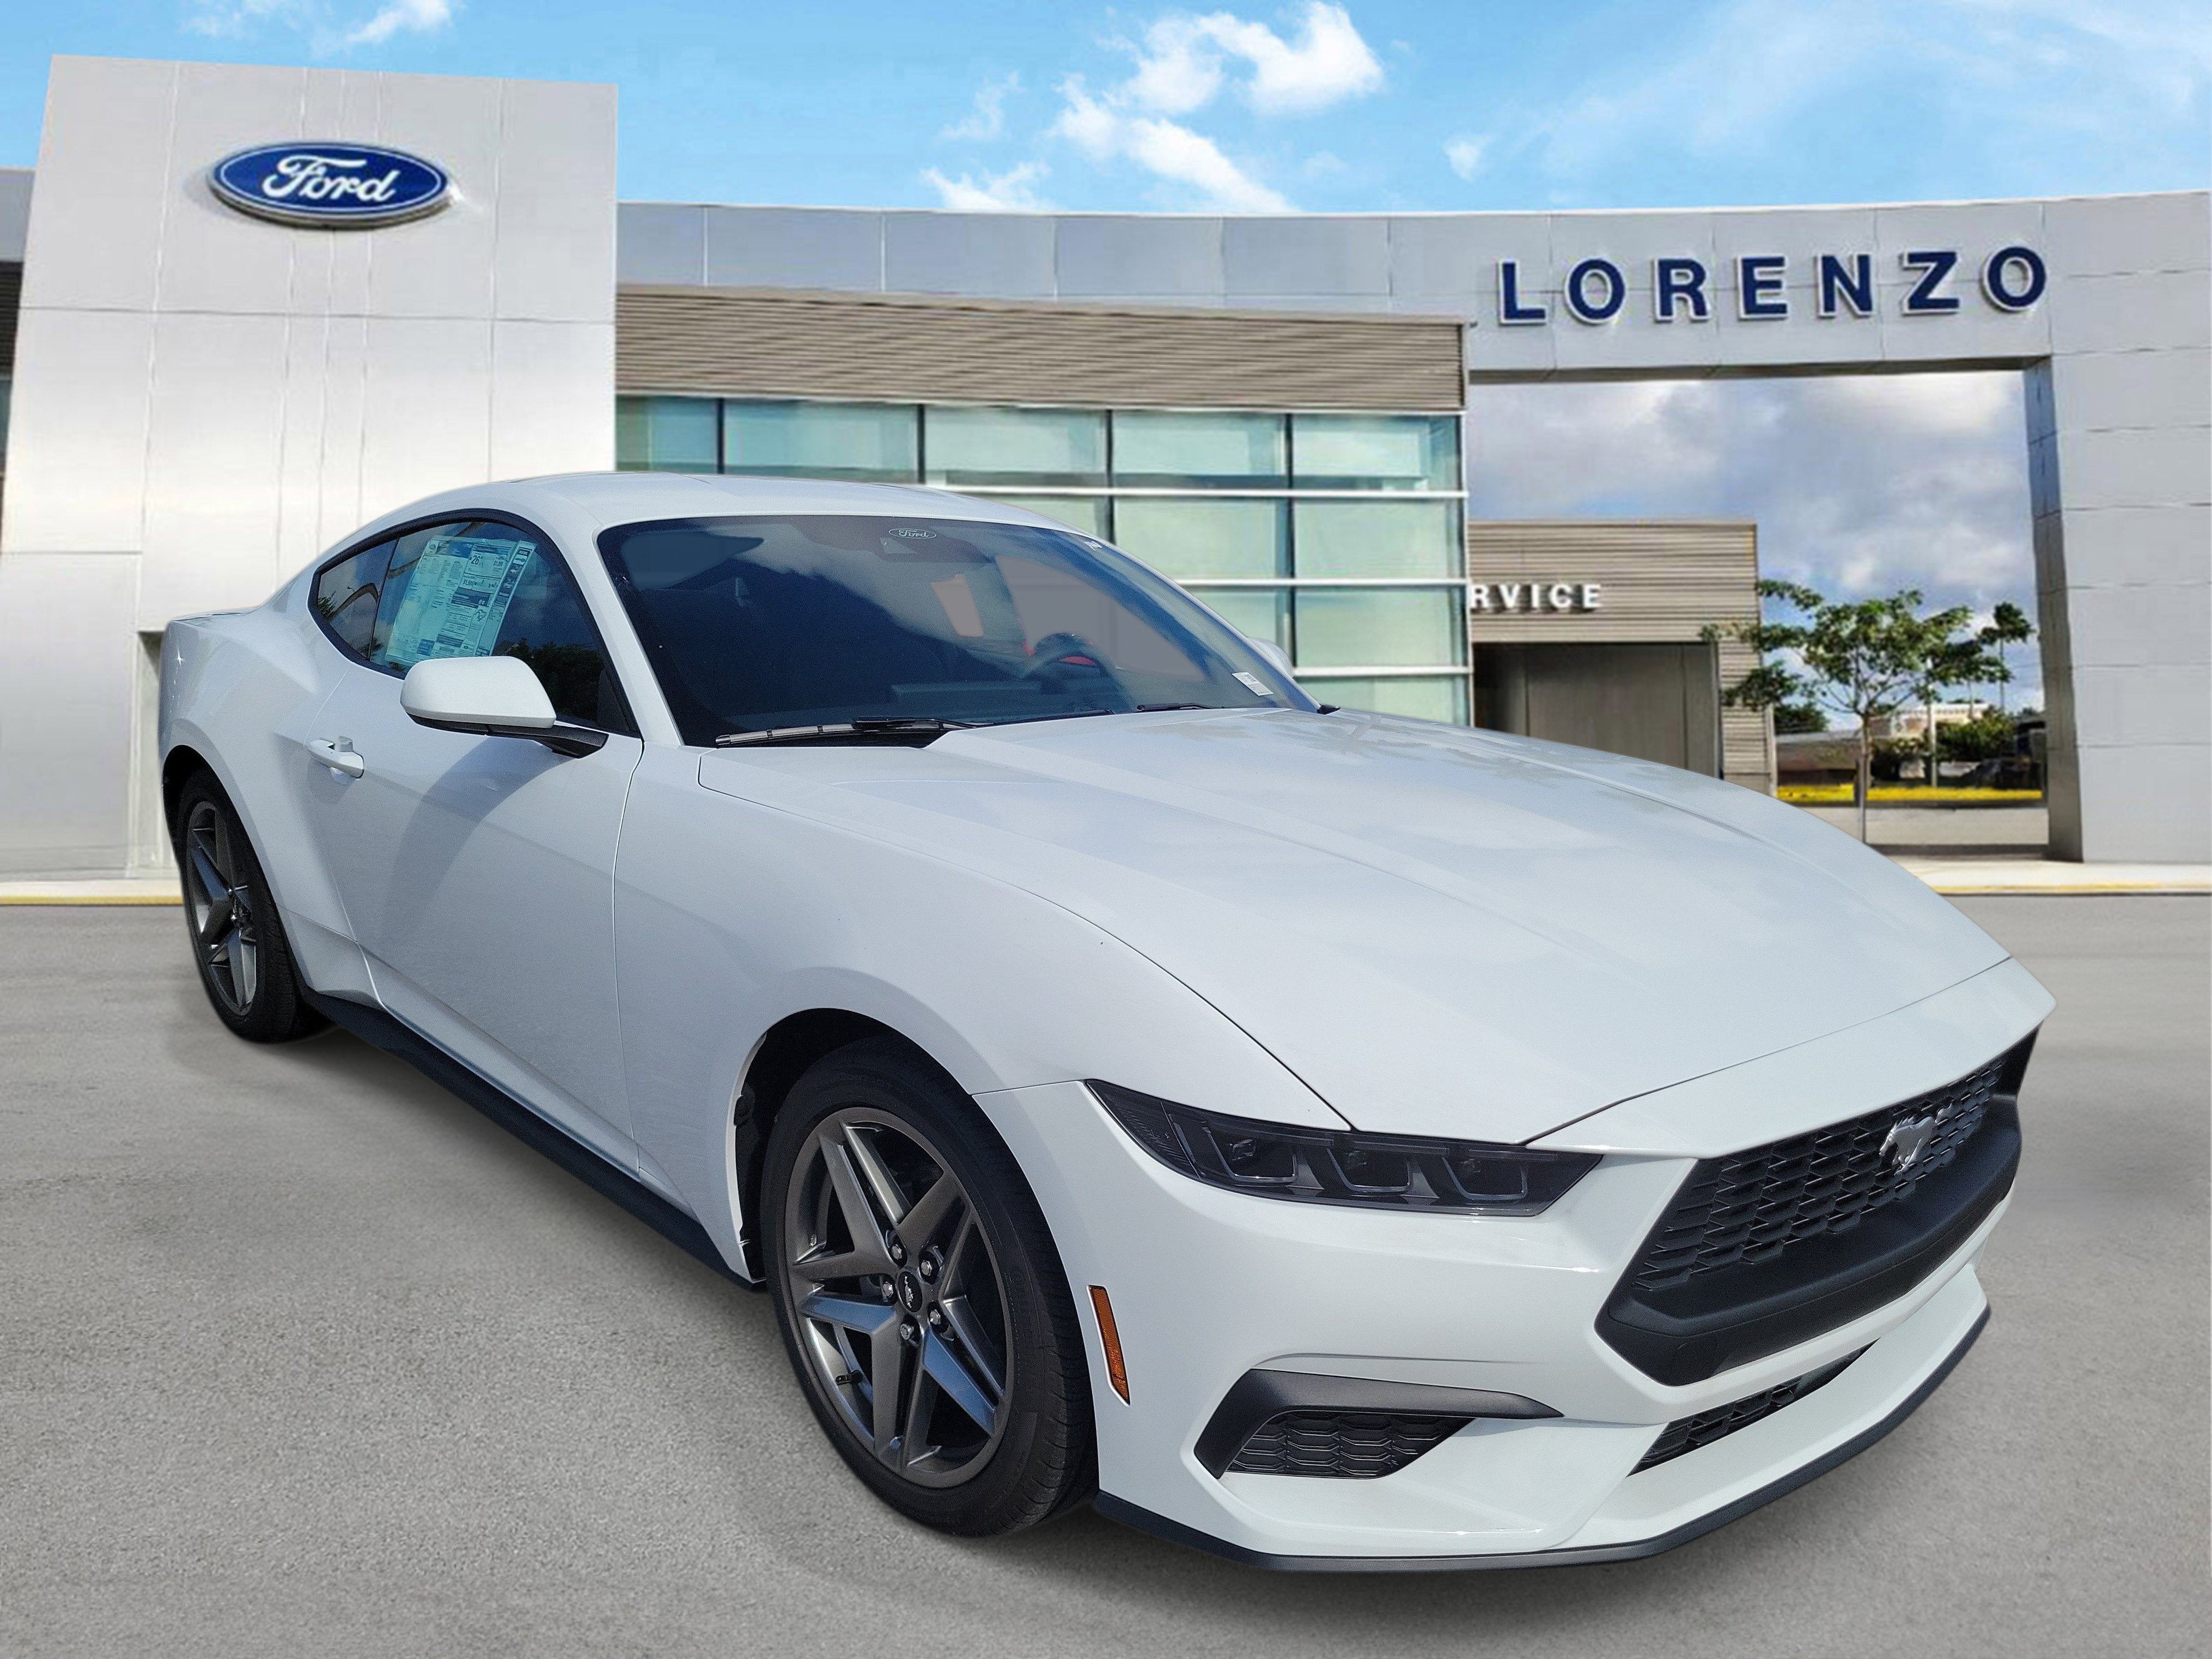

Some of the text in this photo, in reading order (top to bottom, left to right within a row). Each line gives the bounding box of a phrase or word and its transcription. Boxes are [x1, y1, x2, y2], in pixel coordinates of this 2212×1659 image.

[262, 155, 400, 202] Ford
[1500, 246, 2048, 322] LORENZO
[898, 529, 929, 538] Ford
